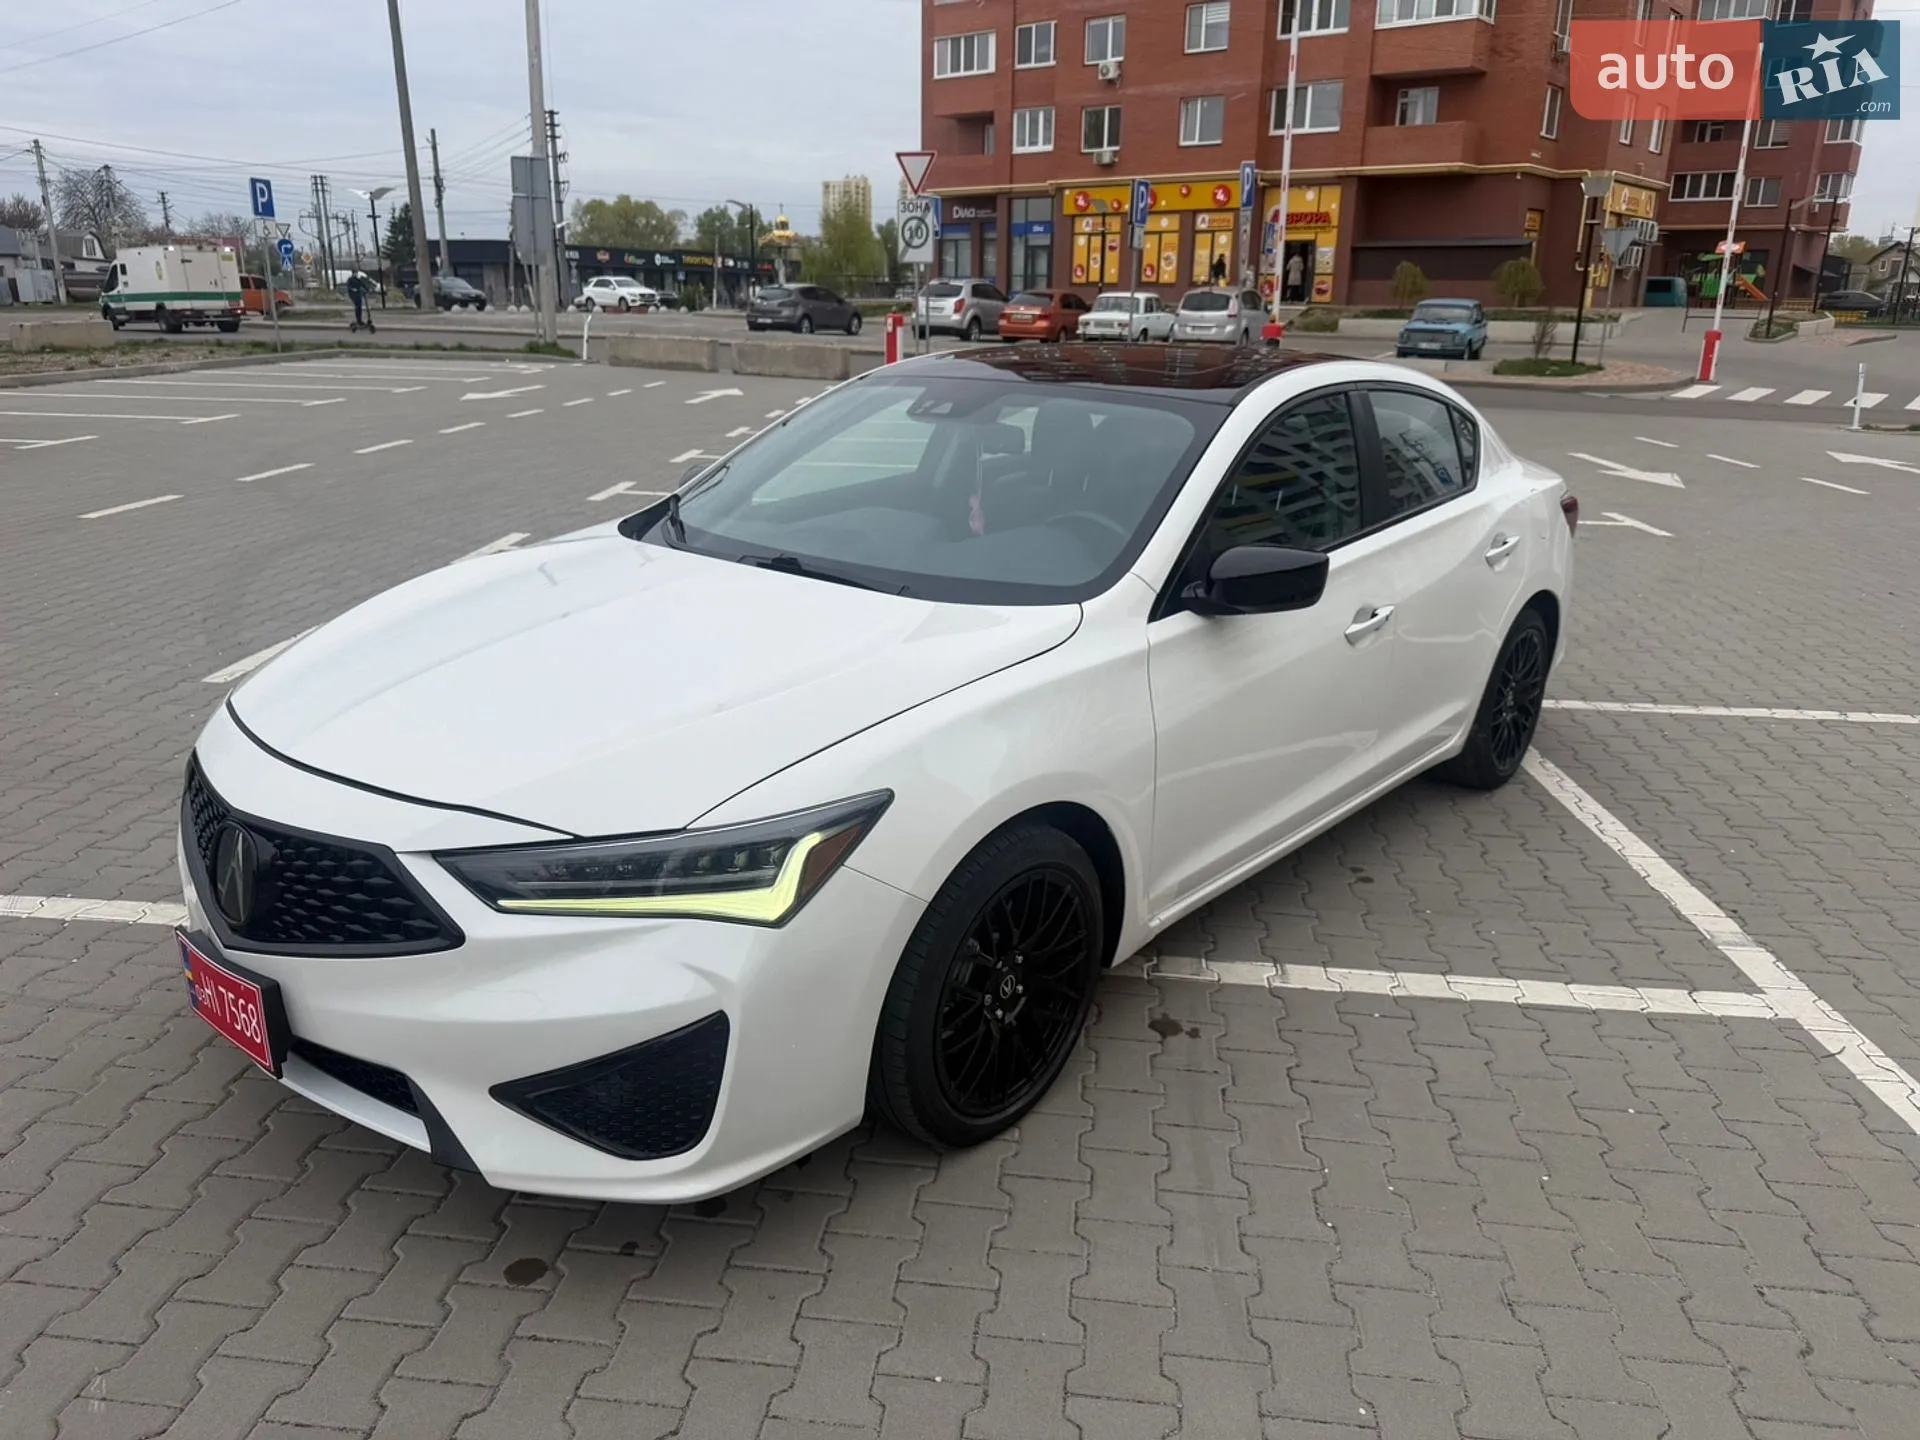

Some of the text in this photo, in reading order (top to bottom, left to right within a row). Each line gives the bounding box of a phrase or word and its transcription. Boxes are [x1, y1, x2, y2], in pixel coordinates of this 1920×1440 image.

[256, 182, 268, 213] P
[1243, 166, 1252, 203] P
[900, 201, 931, 213] ЗОНА
[1137, 185, 1147, 220] P
[907, 225, 924, 240] 10
[218, 985, 260, 1043] 7568
